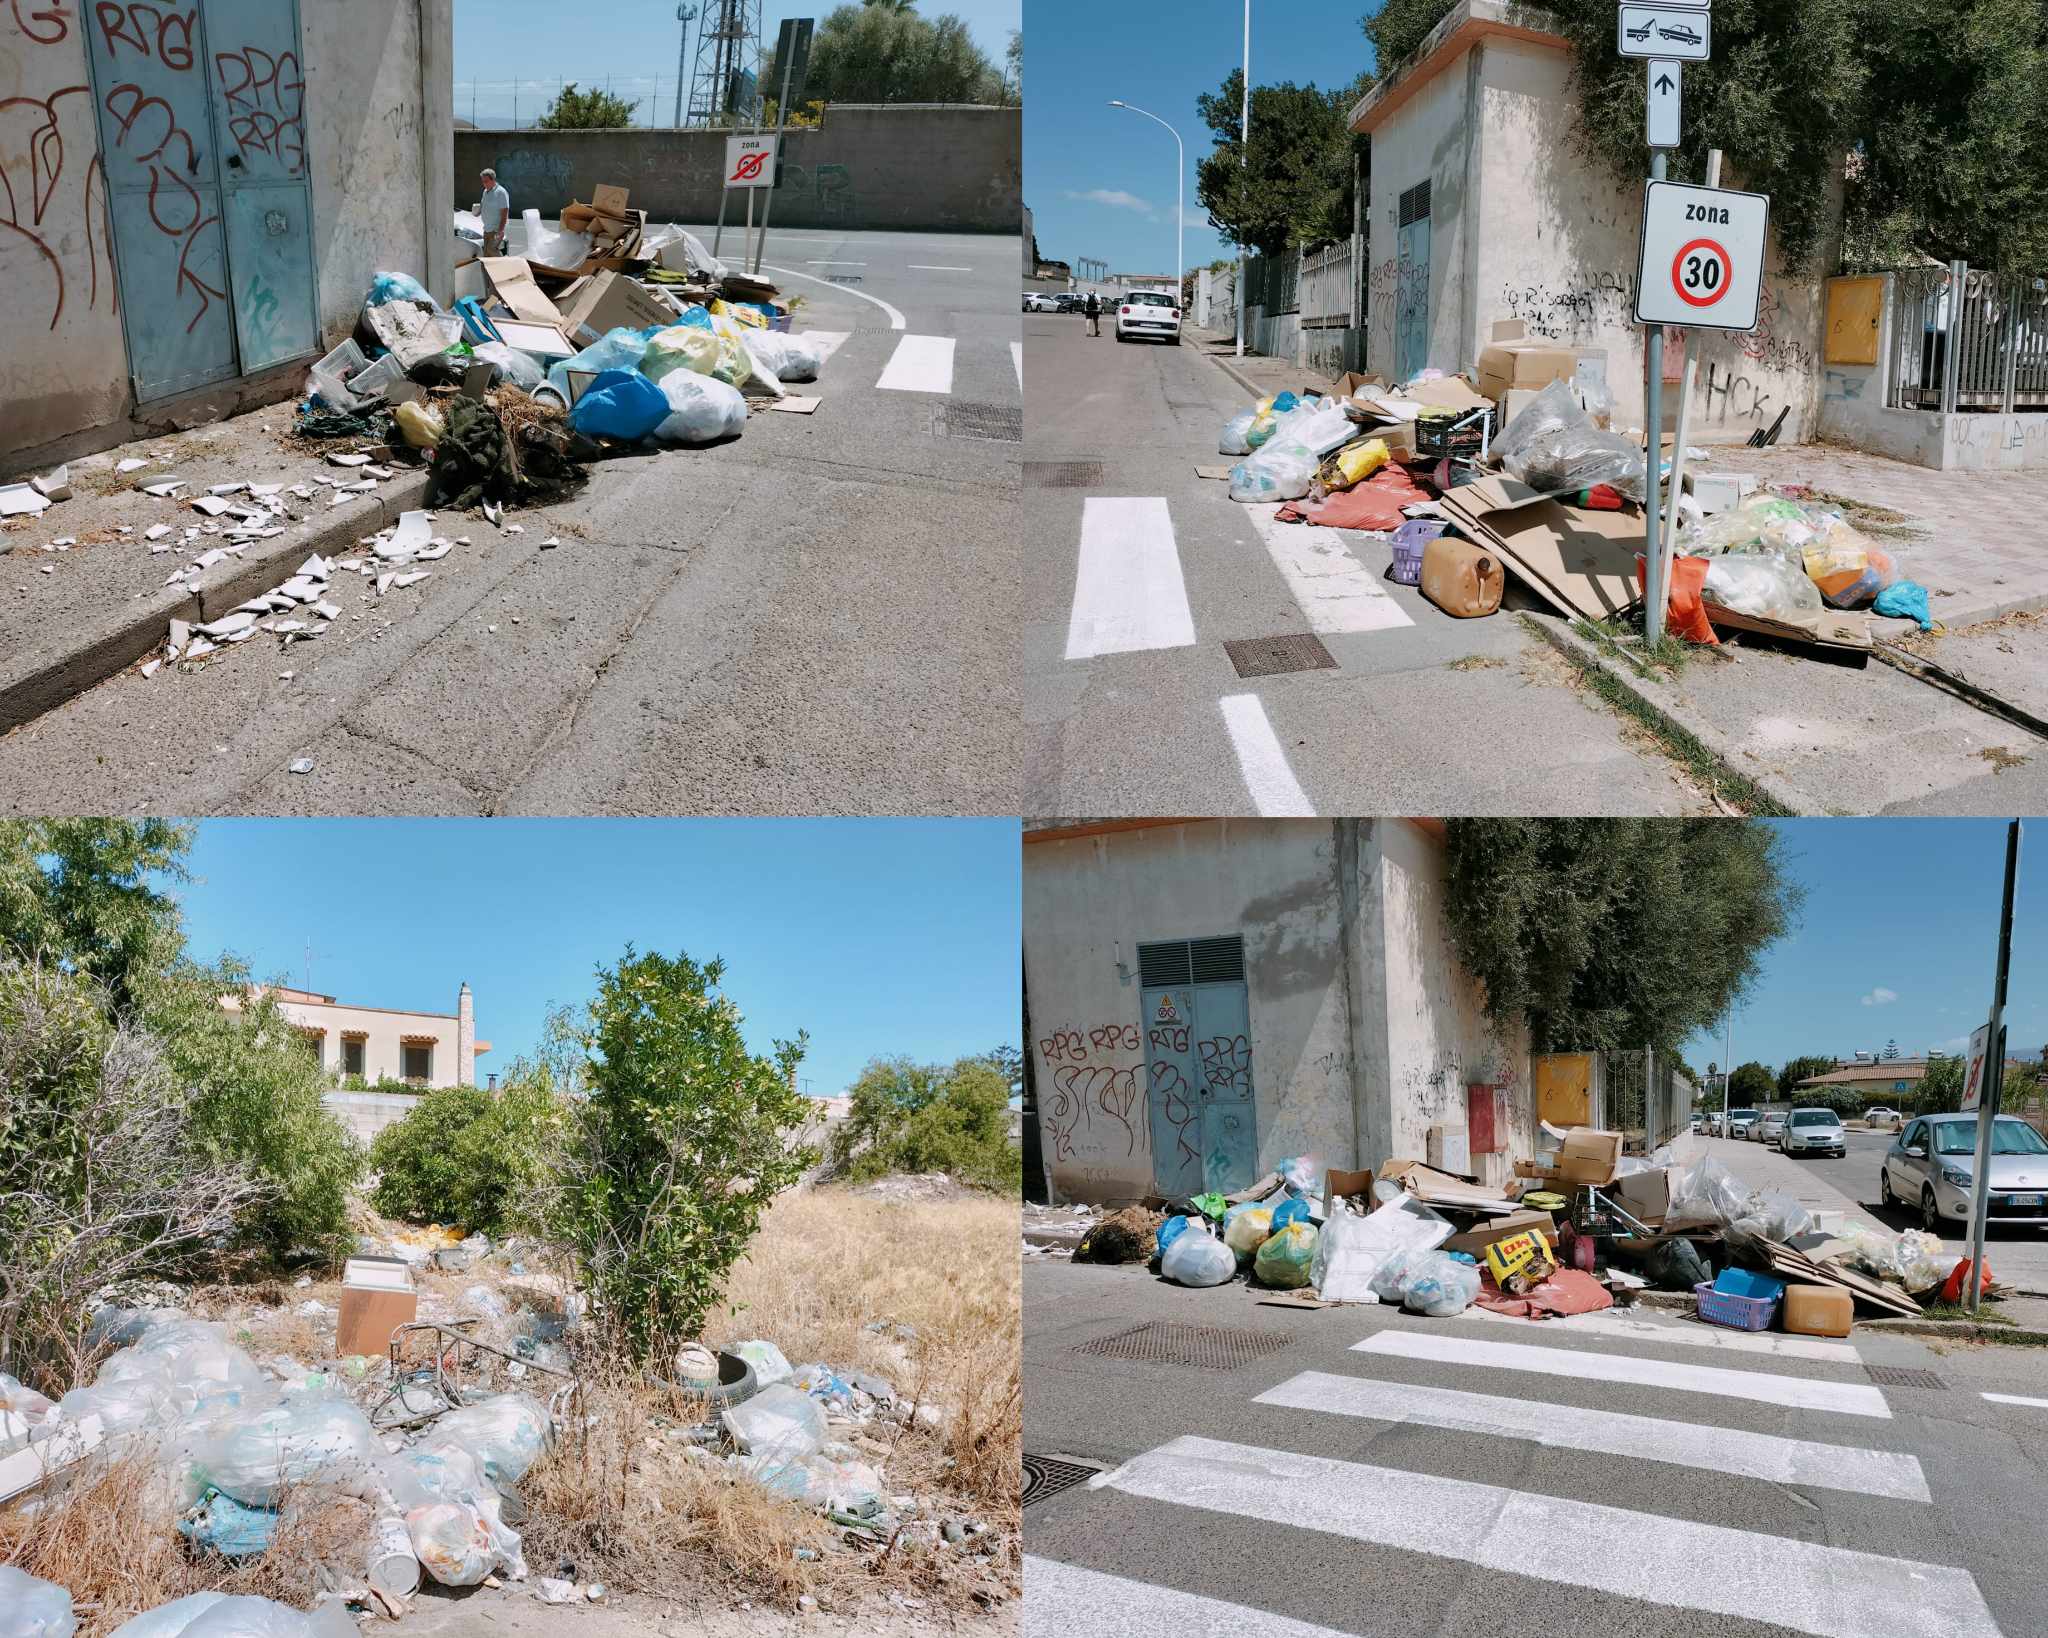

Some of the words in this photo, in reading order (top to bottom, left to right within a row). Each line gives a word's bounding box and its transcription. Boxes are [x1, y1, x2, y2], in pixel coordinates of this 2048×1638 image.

[96, 2, 197, 71] RPG
[215, 46, 307, 120] RPG
[228, 111, 306, 174] RPG
[741, 141, 760, 149] zona
[1685, 203, 1730, 225] zona
[1684, 255, 1720, 290] 30
[1705, 362, 1770, 425] HCK
[1040, 1031, 1088, 1066] RPG
[1089, 1024, 1141, 1051] RPG
[1198, 1034, 1252, 1071] RPG
